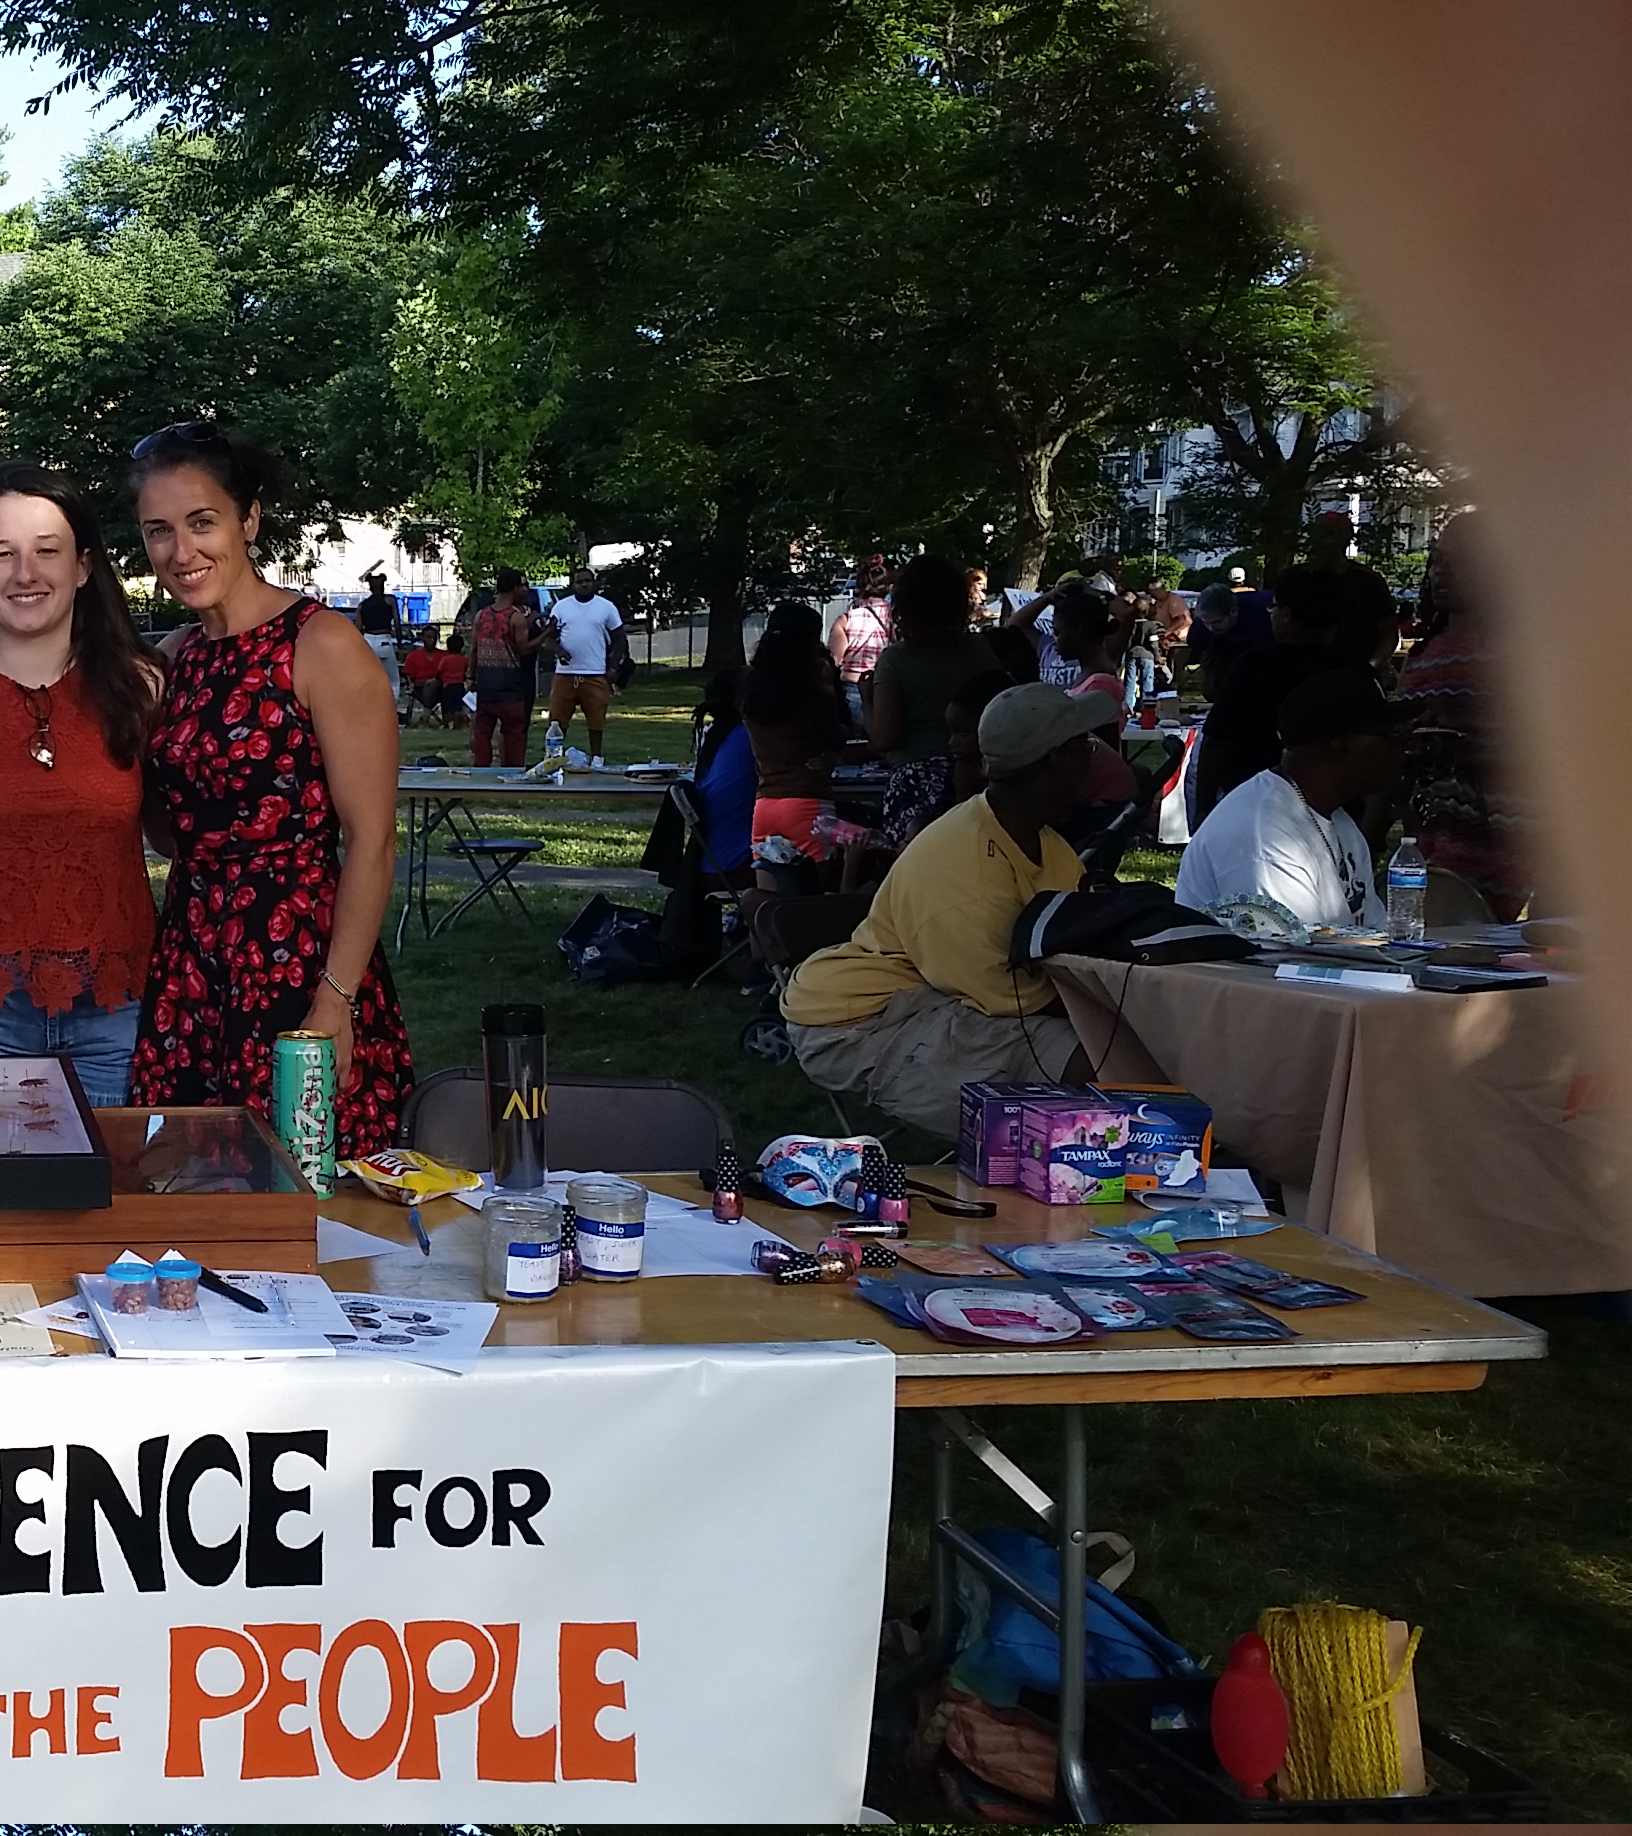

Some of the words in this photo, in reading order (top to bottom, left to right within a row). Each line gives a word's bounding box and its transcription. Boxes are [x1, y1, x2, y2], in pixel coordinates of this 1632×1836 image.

[294, 1046, 329, 1194] AriZona
[1165, 1134, 1201, 1142] INFINITY
[1060, 1150, 1110, 1162] TAMPAX
[1097, 1159, 1123, 1168] radiant
[598, 1223, 625, 1234] Hello
[540, 1243, 558, 1254] Hello
[371, 1468, 552, 1548] FOR
[164, 1618, 639, 1784] PEOPLE
